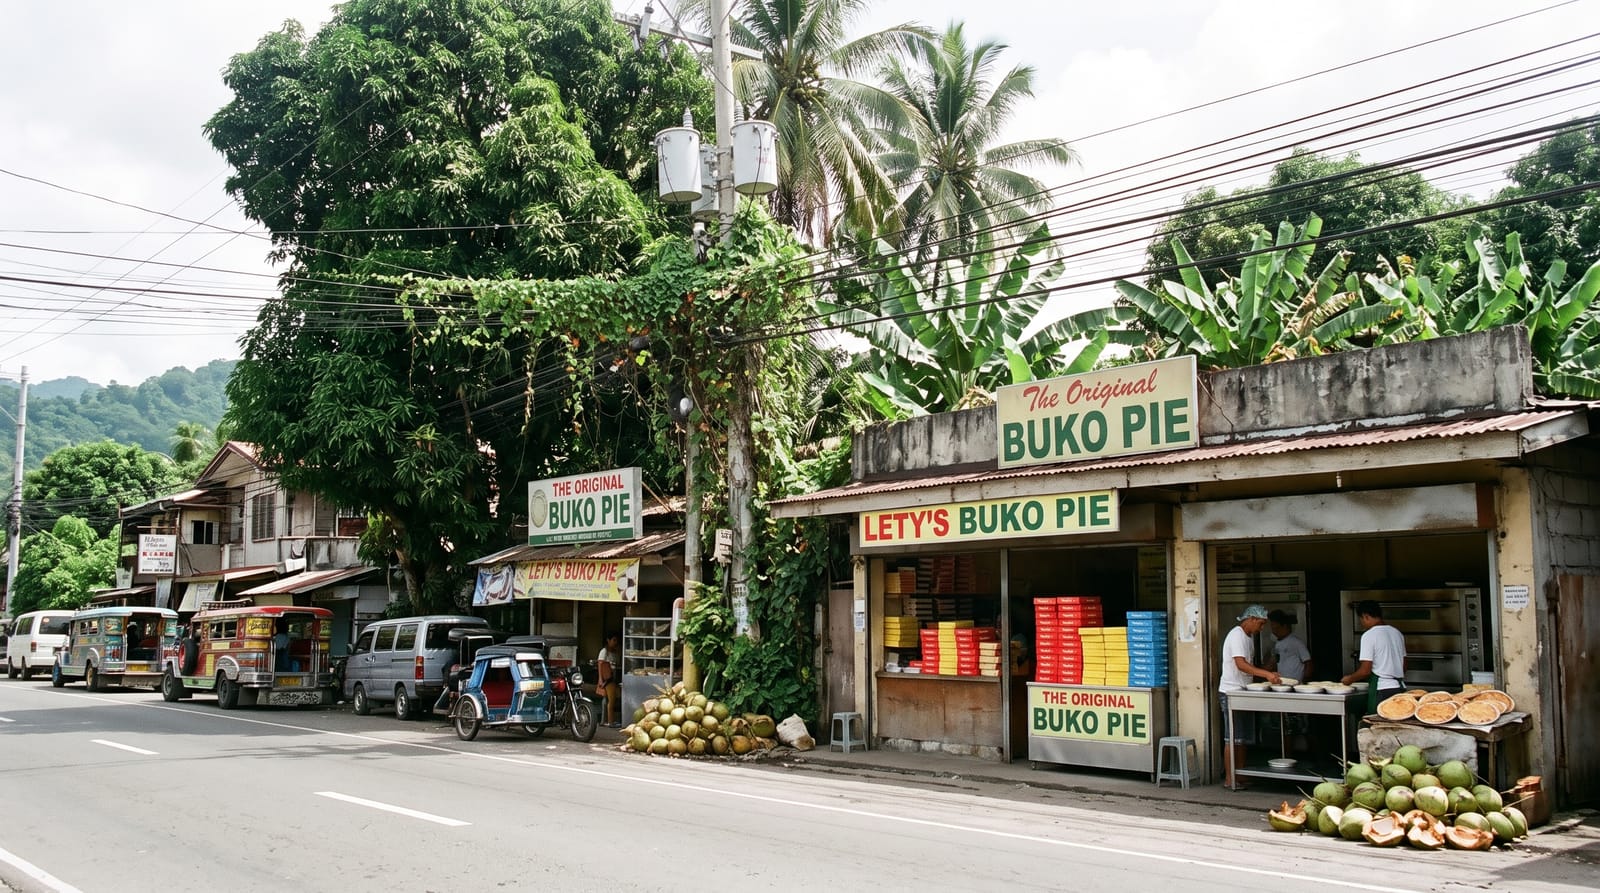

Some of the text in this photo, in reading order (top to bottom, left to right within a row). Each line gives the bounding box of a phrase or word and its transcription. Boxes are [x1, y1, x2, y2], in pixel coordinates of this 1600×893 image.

[1023, 368, 1158, 412] The Original
[1003, 398, 1190, 462] BUKO PIE
[552, 474, 624, 497] THE ORIGINAL
[549, 493, 631, 530] BUKO PIE
[864, 494, 1111, 542] LETY'S BUKO PIE
[528, 561, 618, 581] LETY'S BUKO PIE
[1042, 691, 1135, 709] THE ORIGINAL
[1033, 707, 1147, 739] BUKO PIE
